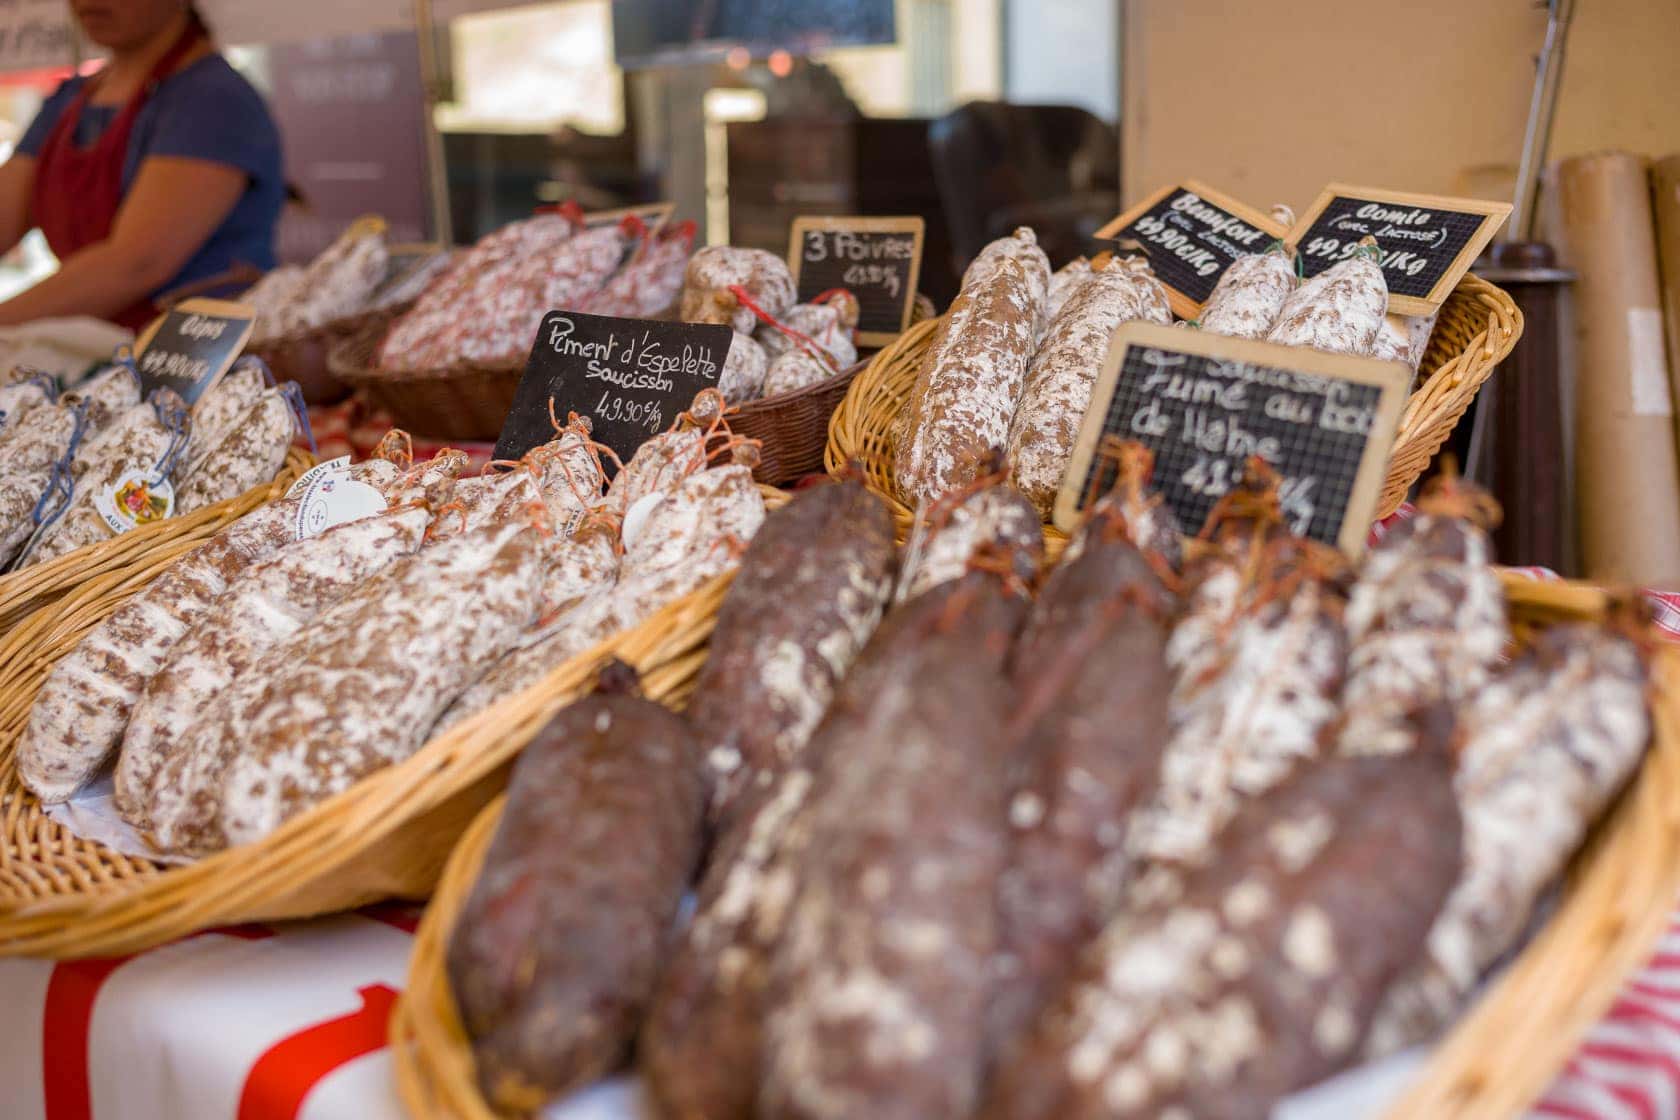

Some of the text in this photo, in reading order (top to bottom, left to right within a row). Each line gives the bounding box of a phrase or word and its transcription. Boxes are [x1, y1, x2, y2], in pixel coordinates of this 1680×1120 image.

[805, 229, 828, 262] 3
[549, 317, 619, 361] Piment
[585, 359, 674, 392] Saucisson
